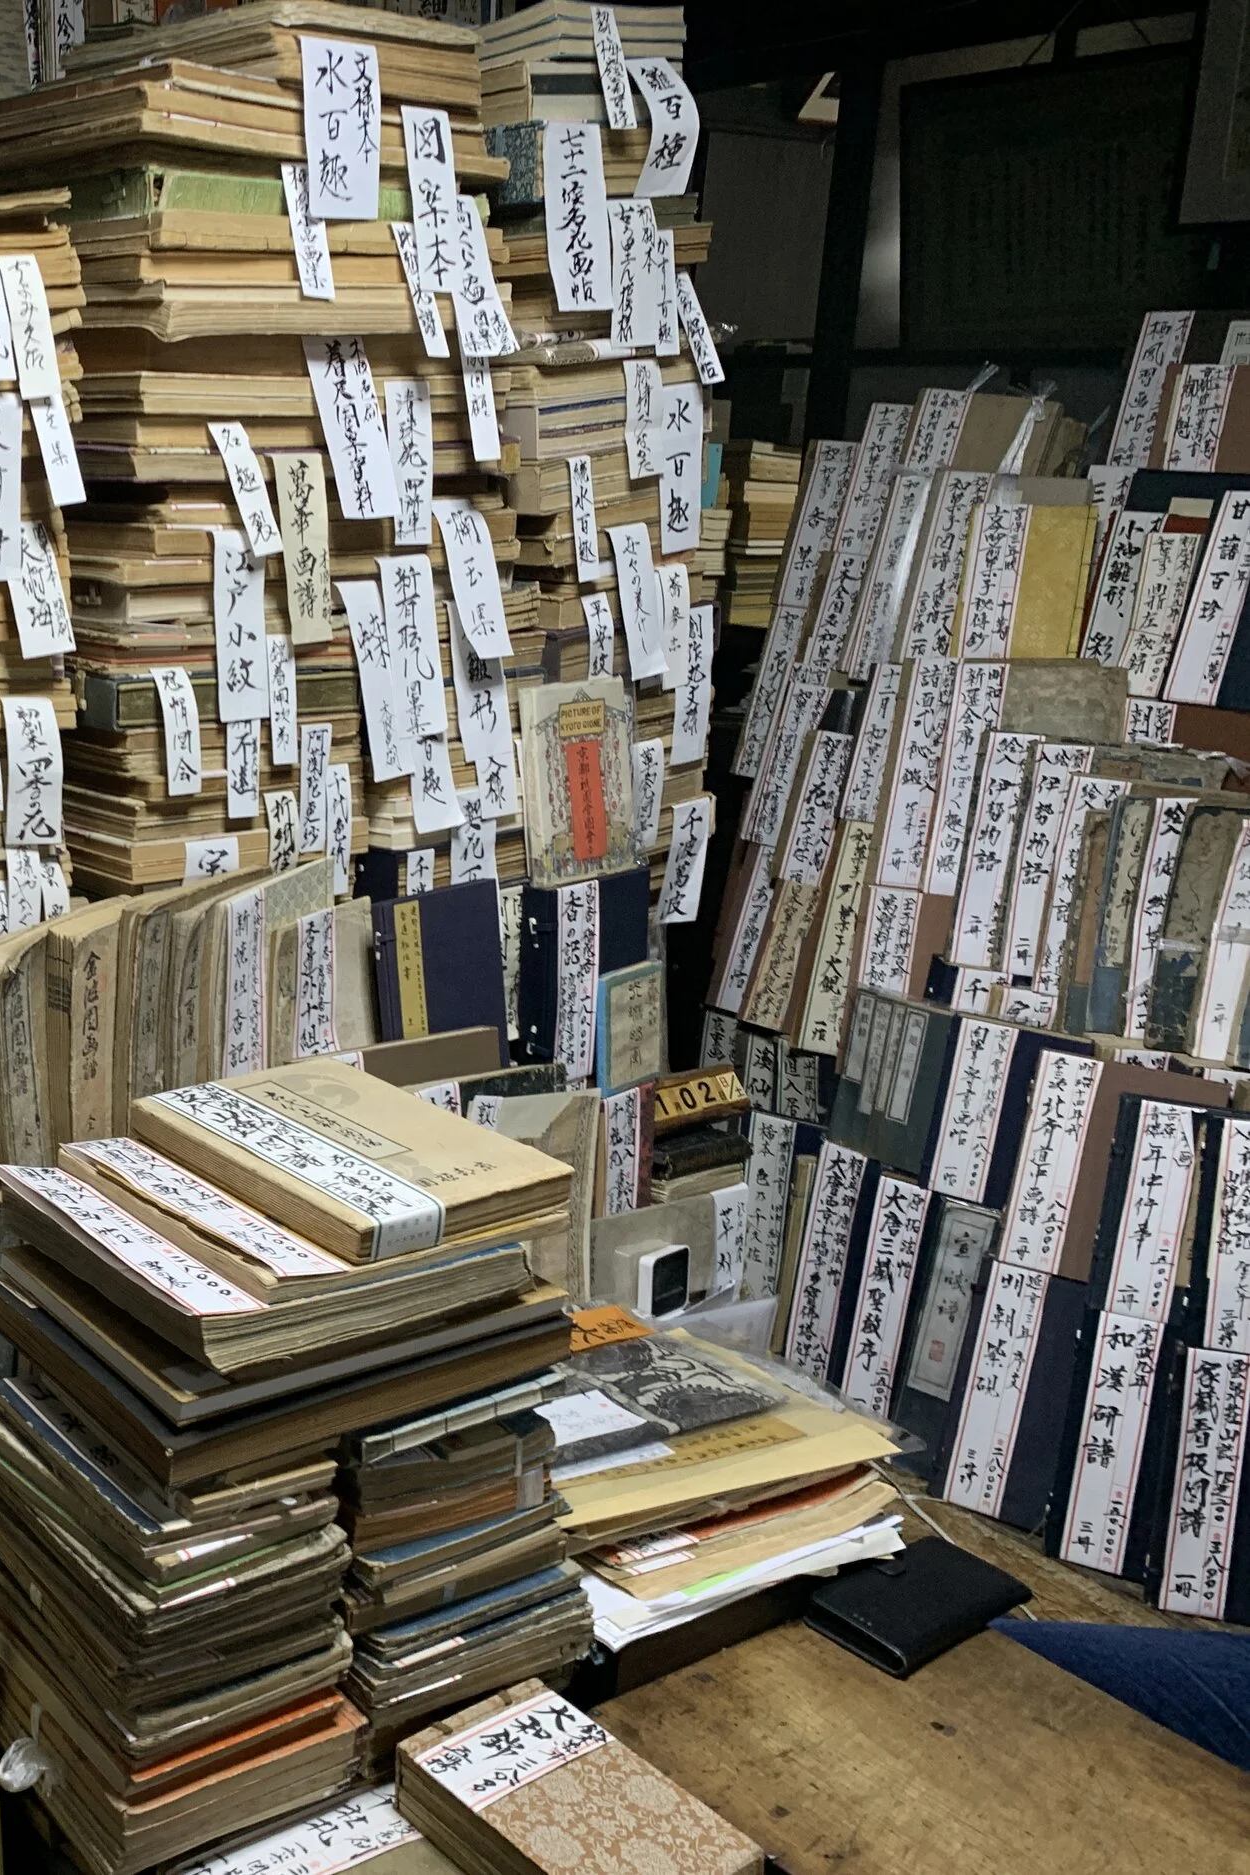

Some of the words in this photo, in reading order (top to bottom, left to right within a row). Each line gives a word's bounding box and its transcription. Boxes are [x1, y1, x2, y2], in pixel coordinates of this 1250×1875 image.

[314, 49, 353, 202] 水百趣
[666, 399, 693, 534] 水百趣
[973, 777, 1015, 874] 伊勢物語
[1021, 775, 1062, 887] 伊勢物語
[1127, 1142, 1167, 1262] 年中行事
[1169, 1571, 1198, 1599] 一冊
[479, 1702, 577, 1759] 大和錦
